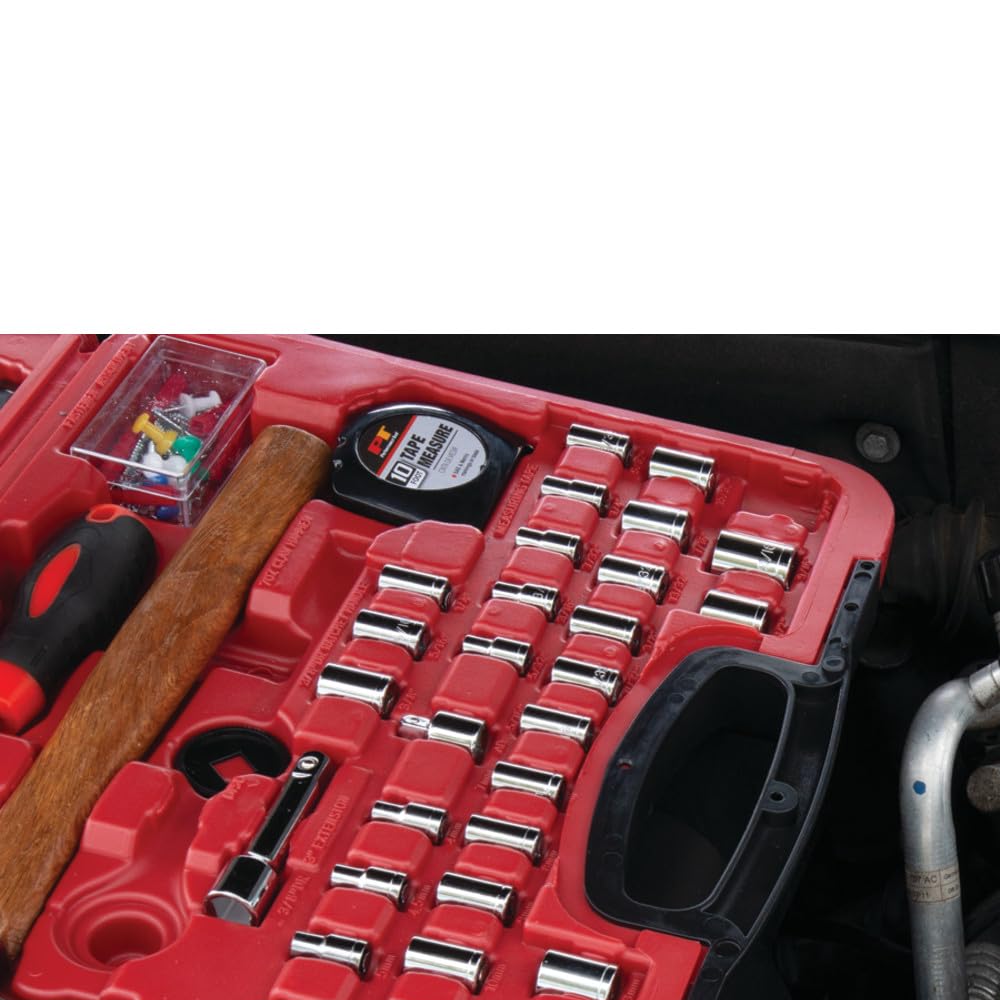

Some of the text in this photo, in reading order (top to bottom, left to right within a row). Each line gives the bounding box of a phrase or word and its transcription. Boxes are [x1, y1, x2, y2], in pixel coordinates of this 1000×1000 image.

[367, 425, 391, 456] PT
[400, 434, 426, 461] TAPE
[417, 424, 453, 469] MEASURE
[391, 462, 414, 483] 10
[410, 471, 423, 485] FOOT
[312, 794, 350, 849] EXTENSION
